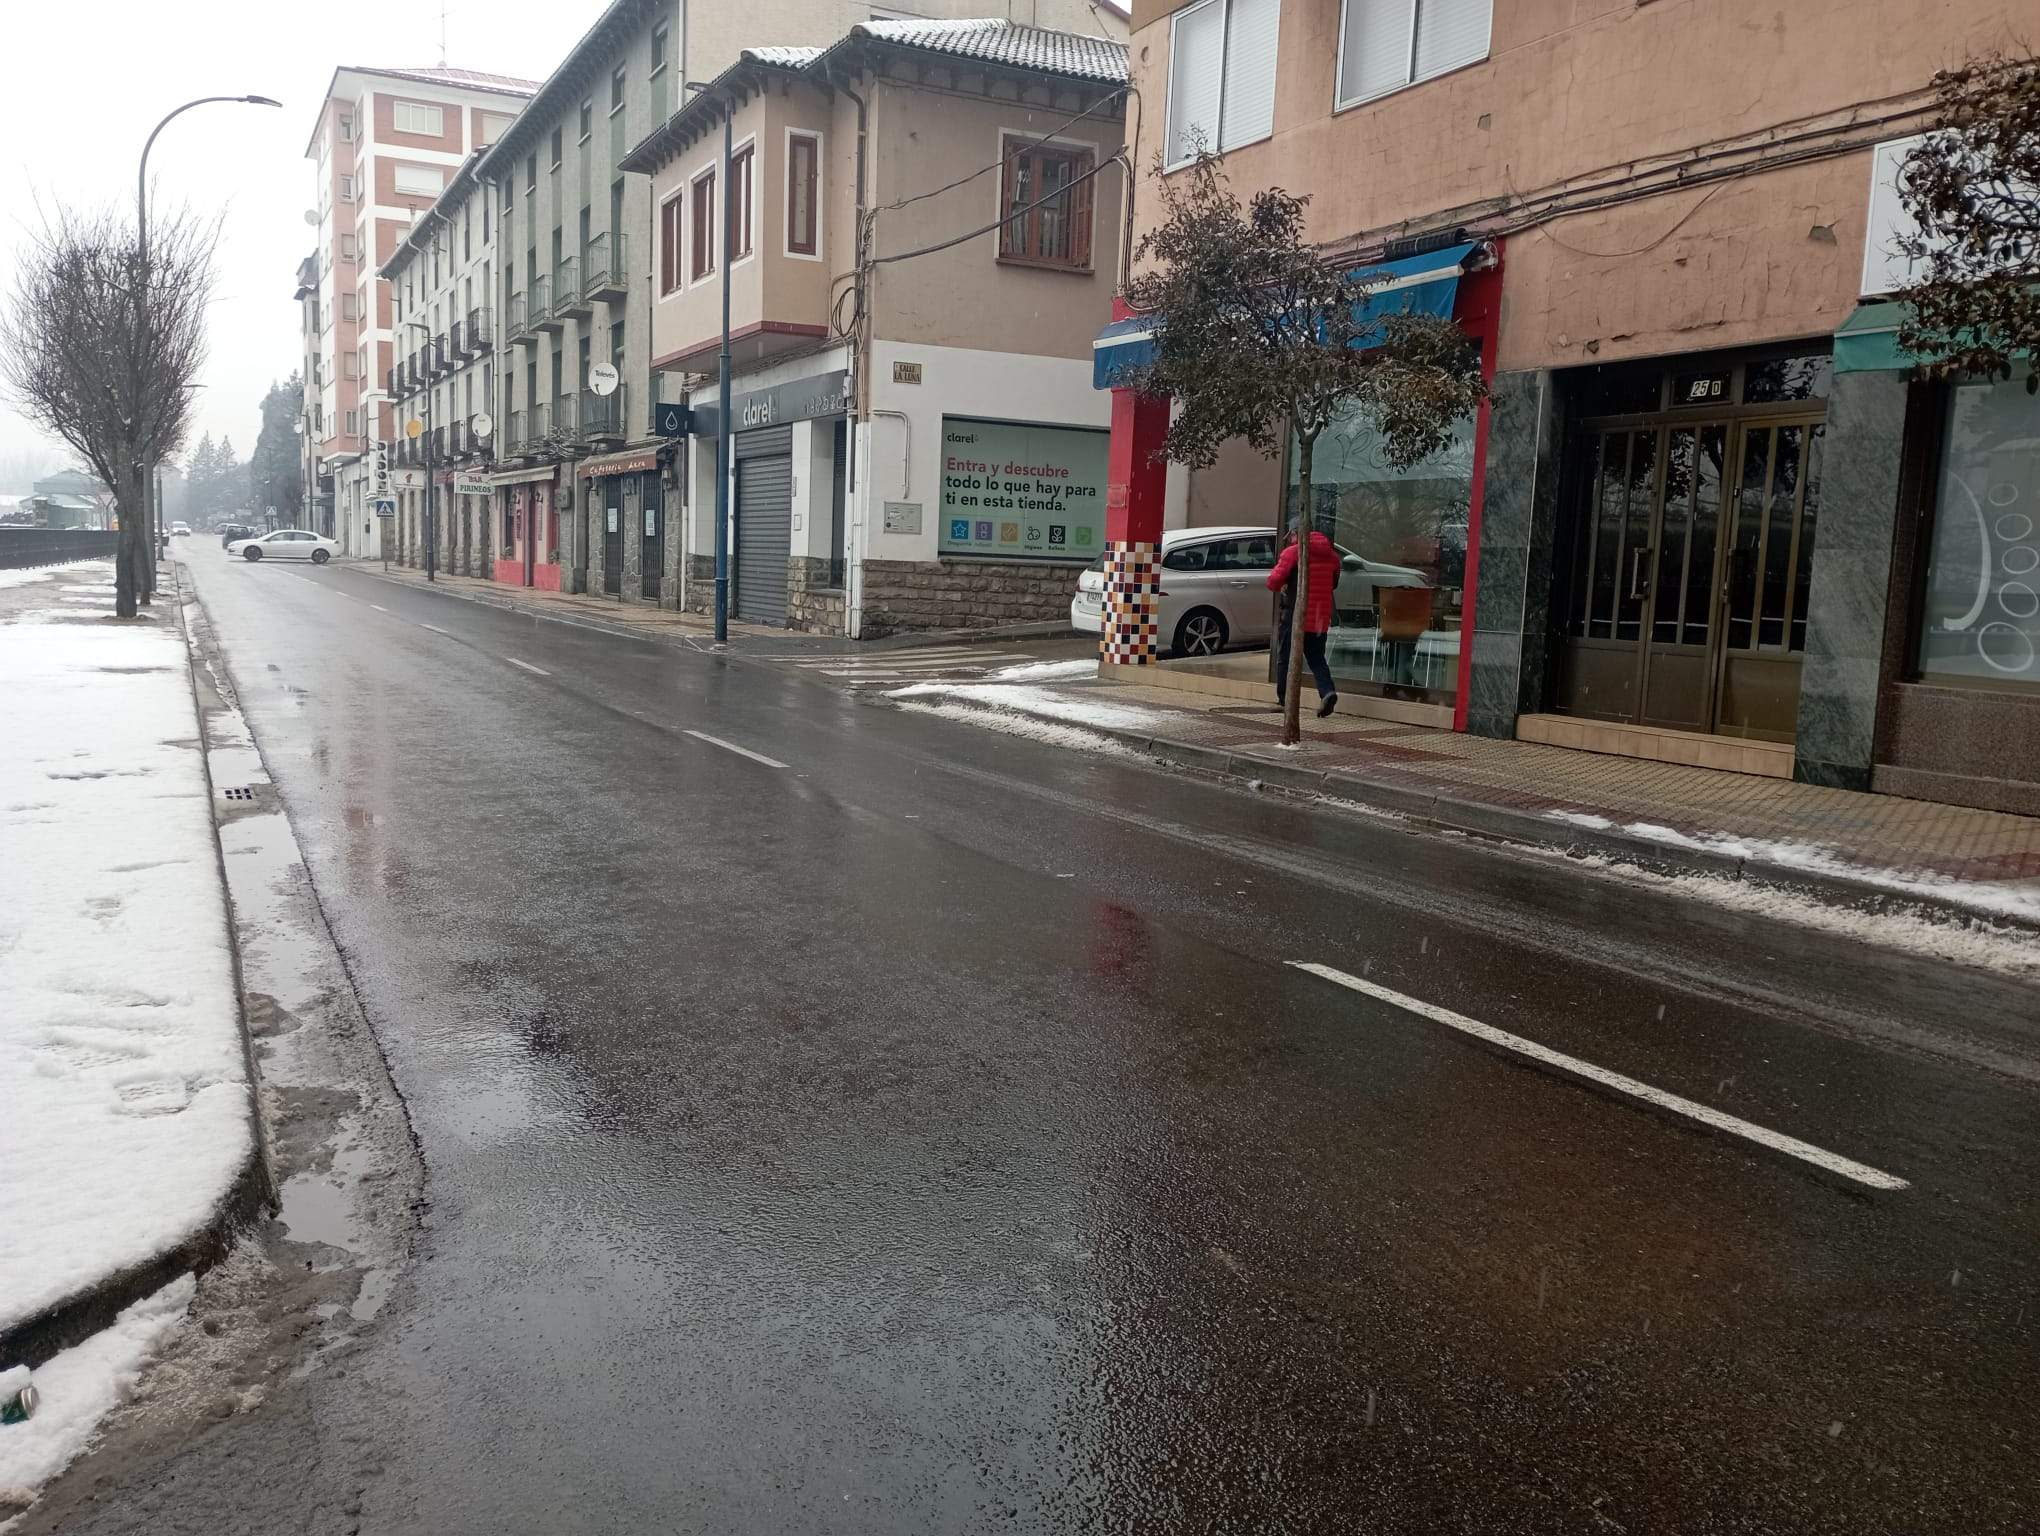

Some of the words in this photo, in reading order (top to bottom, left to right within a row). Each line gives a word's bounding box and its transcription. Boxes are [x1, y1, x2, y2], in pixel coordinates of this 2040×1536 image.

[1692, 381, 1708, 396] 25
[743, 395, 772, 426] clarel
[946, 433, 975, 444] clarel
[947, 457, 986, 473] Entra
[991, 463, 999, 477] y
[1004, 461, 1070, 478] descubre
[460, 484, 491, 493] PIRINEOS
[946, 475, 981, 489] todo
[986, 476, 999, 490] lo
[1004, 481, 1030, 496] que
[1036, 480, 1060, 498] hay
[1065, 485, 1096, 498] para
[945, 492, 956, 505] ti
[960, 495, 978, 507] en
[983, 495, 1013, 508] esta
[1018, 496, 1066, 512] tienda.
